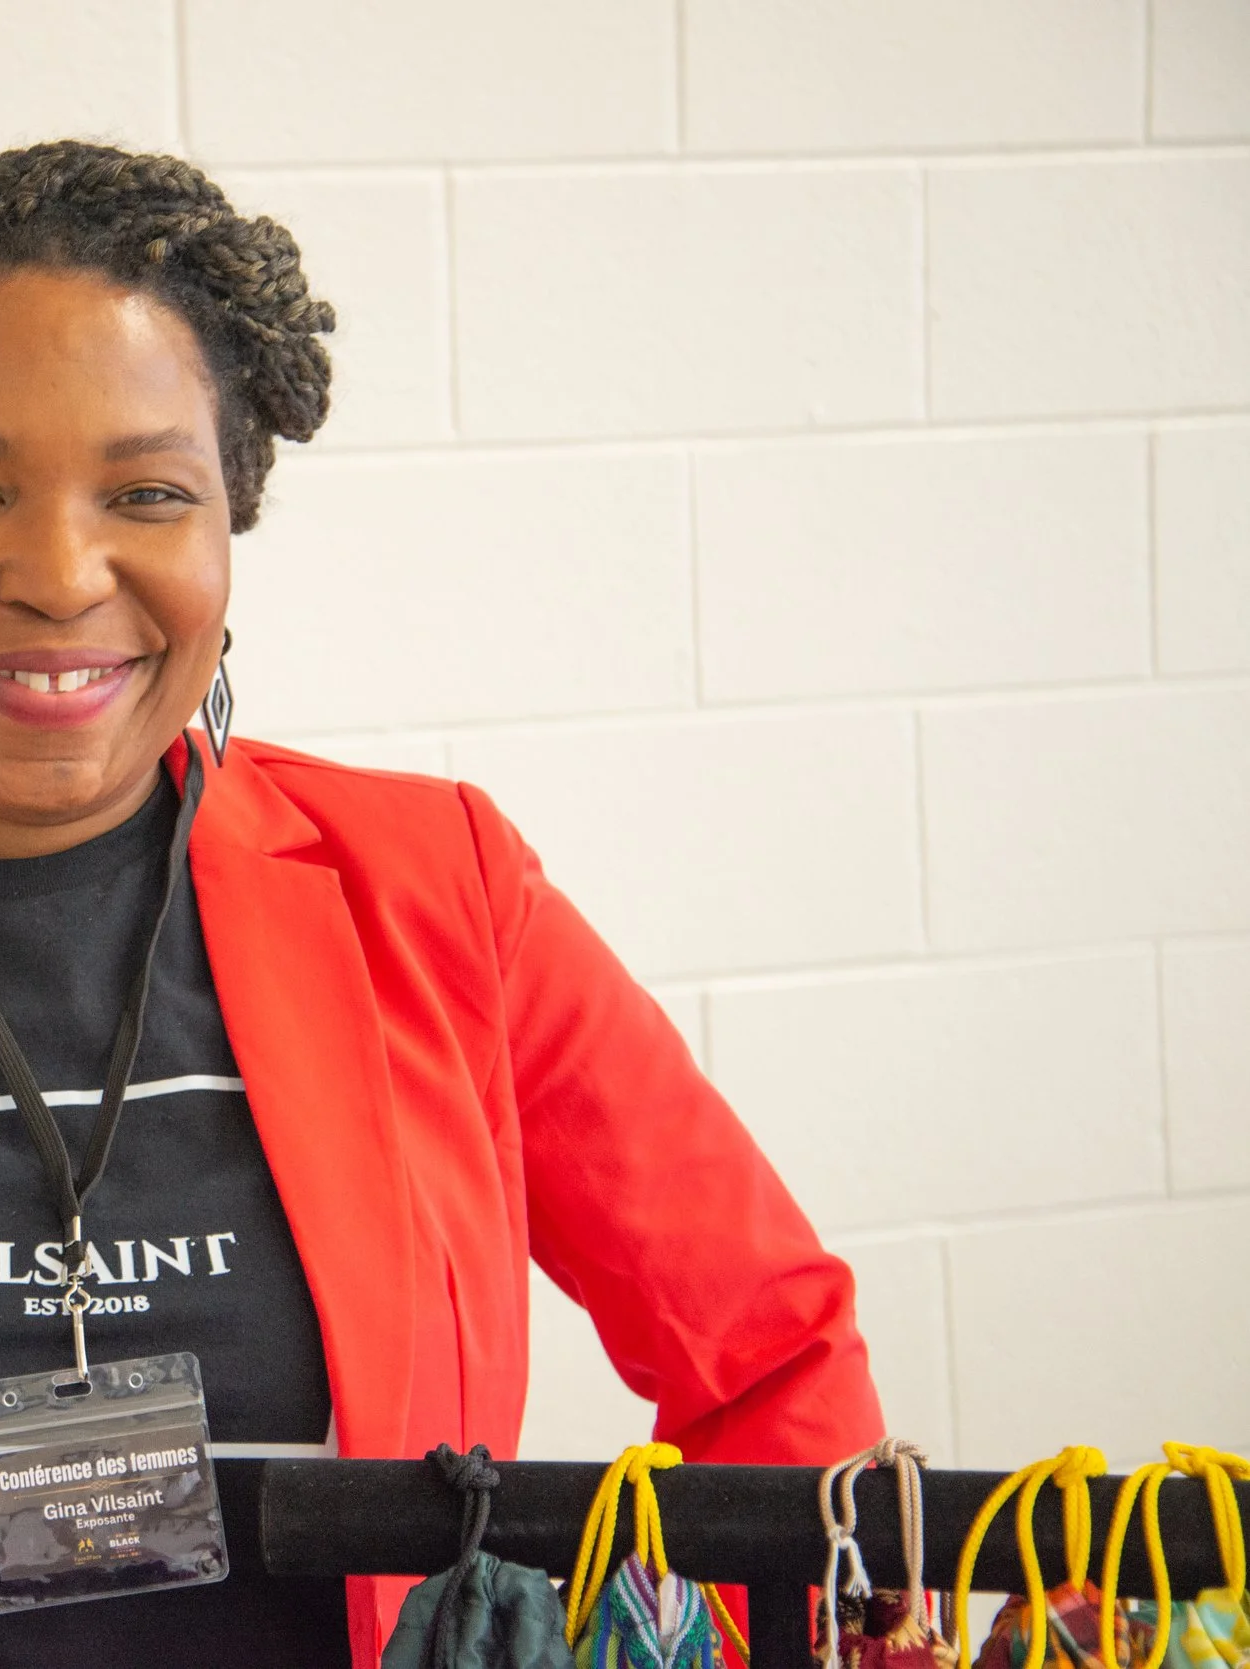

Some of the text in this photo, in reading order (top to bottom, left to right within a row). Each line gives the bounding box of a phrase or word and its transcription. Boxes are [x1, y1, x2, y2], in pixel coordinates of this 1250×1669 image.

[89, 1295, 150, 1315] 2018
[0, 1446, 198, 1491] Conférence des femmes
[43, 1489, 164, 1520] Gina Vilsaint
[76, 1512, 136, 1529] Exposante
[109, 1536, 141, 1548] BLACK
